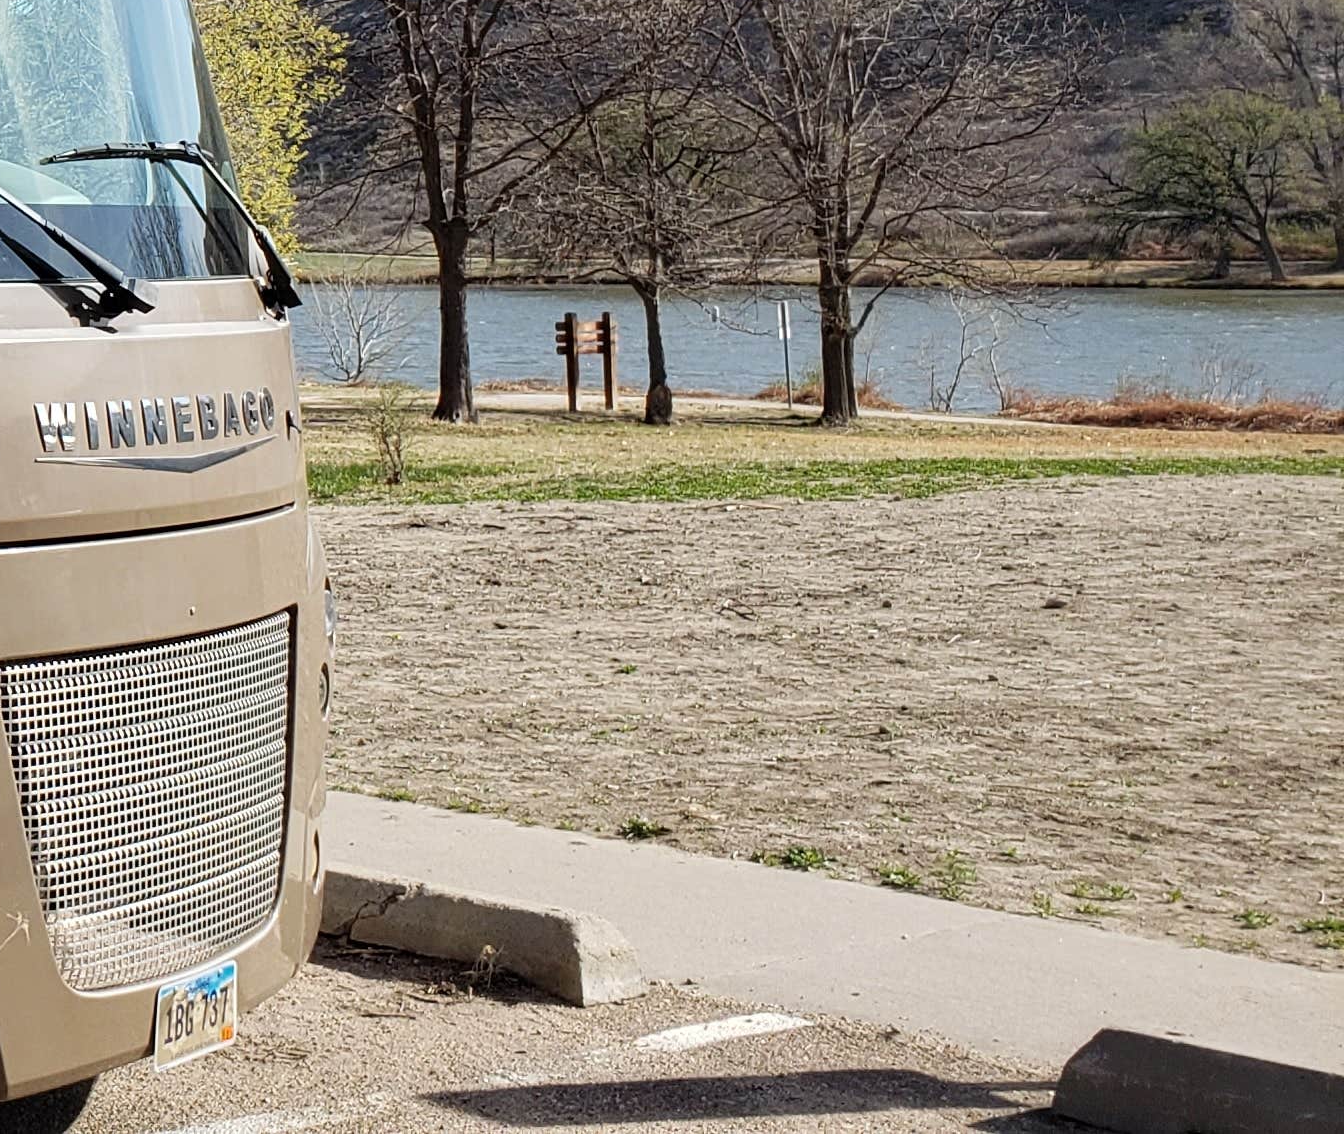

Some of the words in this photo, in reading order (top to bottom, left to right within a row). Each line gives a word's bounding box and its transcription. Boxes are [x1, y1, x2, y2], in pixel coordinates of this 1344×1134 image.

[33, 386, 275, 452] WINNEBAGO
[164, 999, 194, 1044] 1BG
[201, 986, 229, 1031] 737
